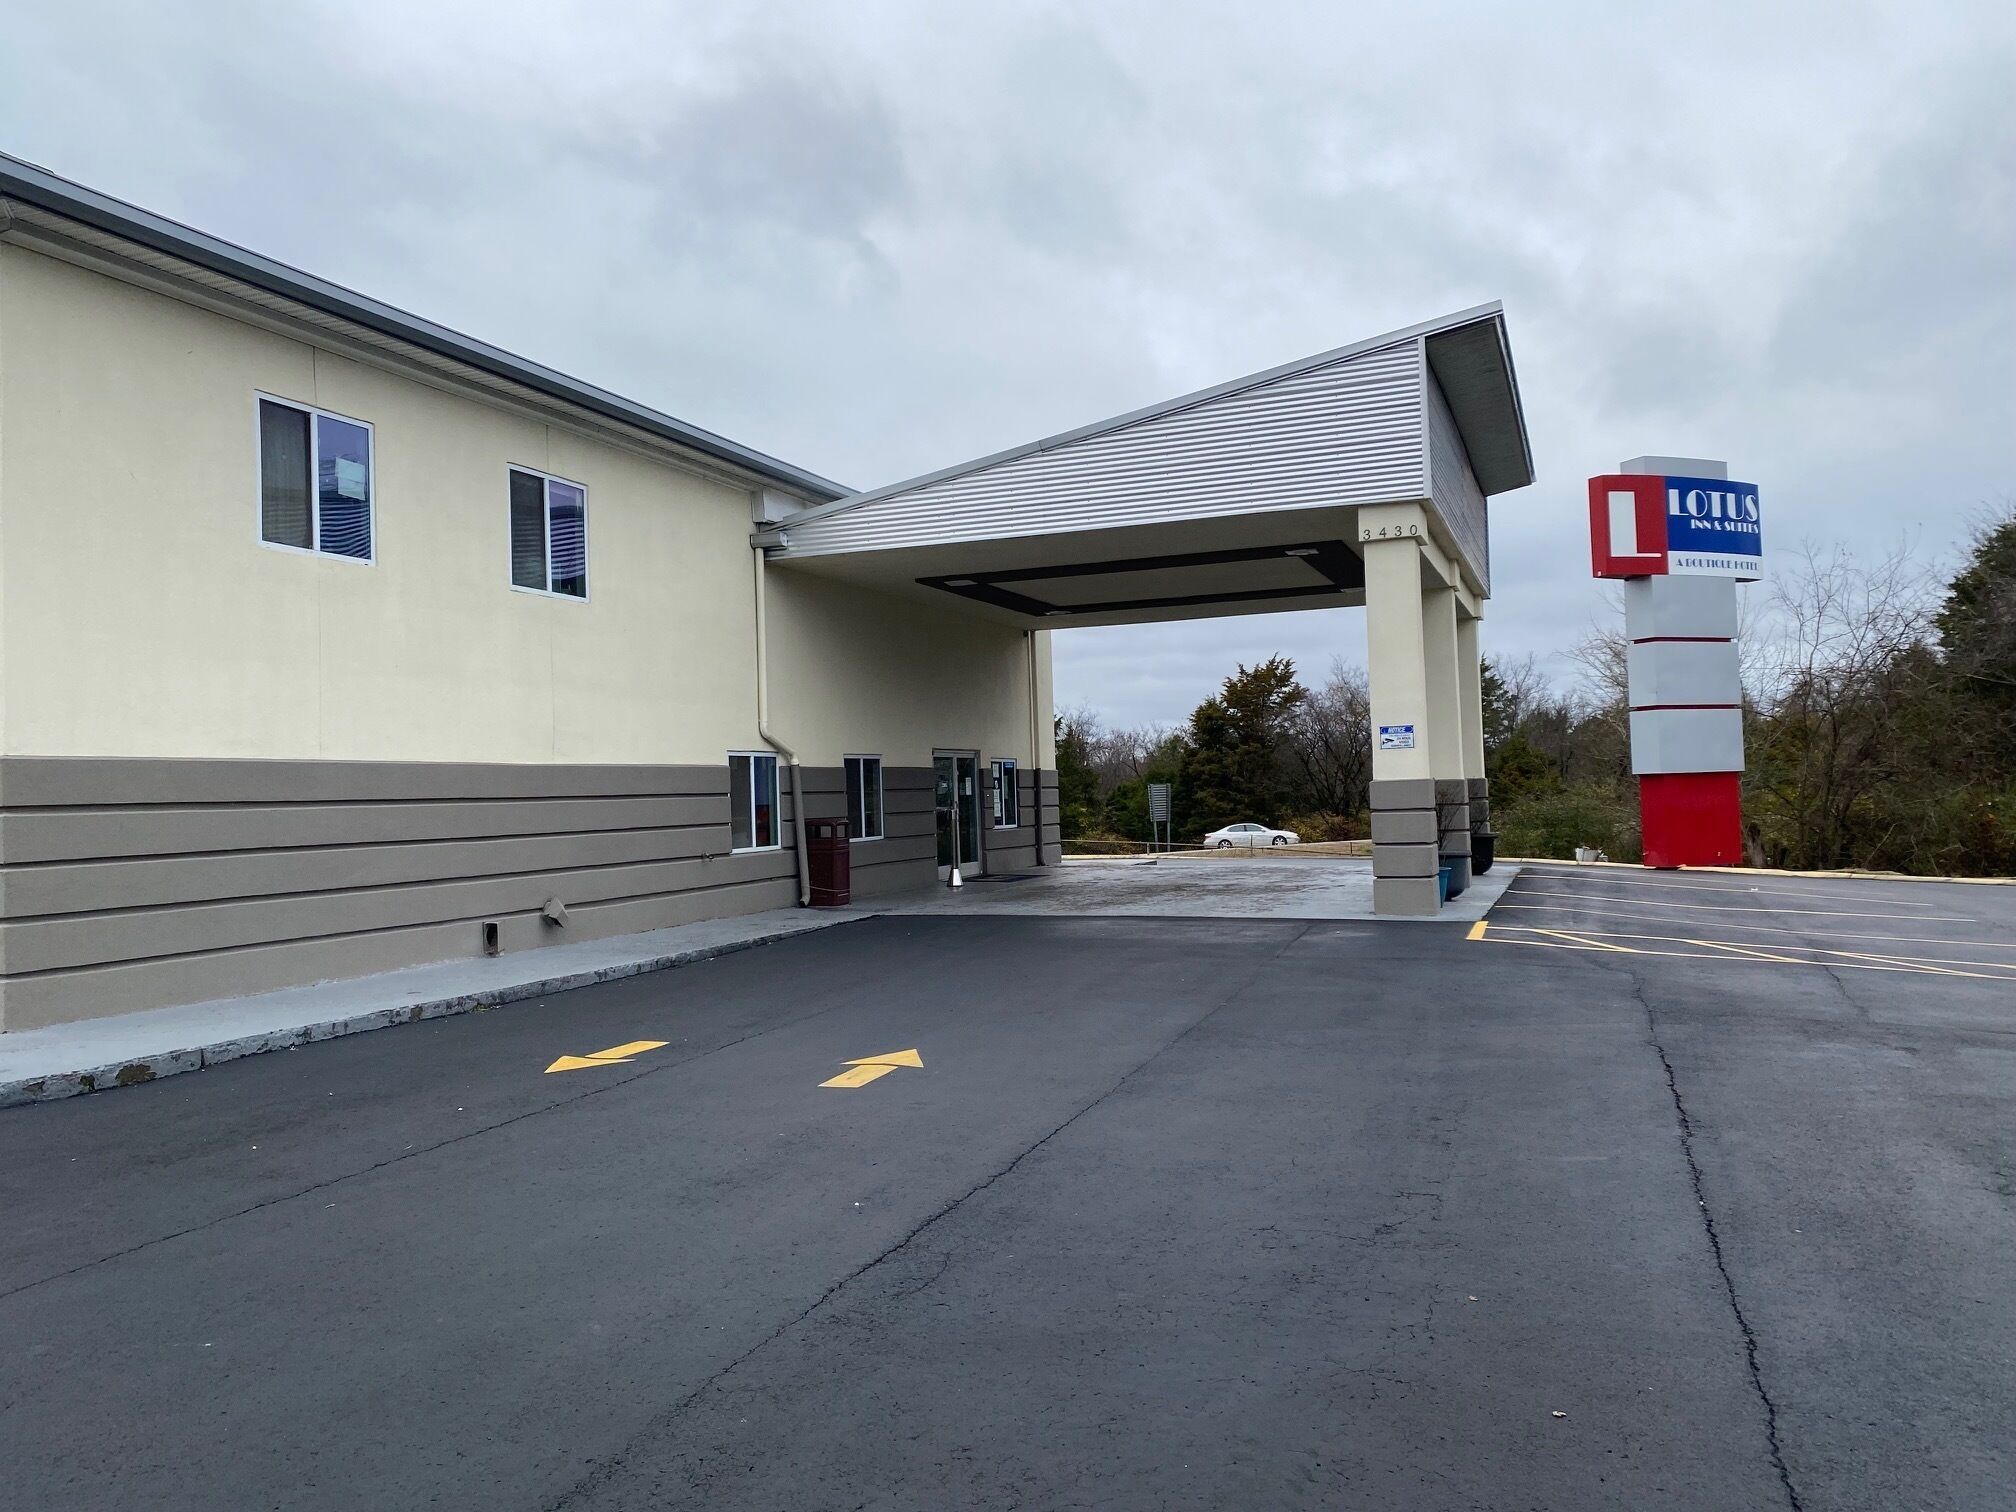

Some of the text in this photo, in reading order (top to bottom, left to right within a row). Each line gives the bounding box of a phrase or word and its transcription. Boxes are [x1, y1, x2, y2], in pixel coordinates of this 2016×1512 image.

[1668, 489, 1758, 521] LOTUS
[1363, 524, 1418, 540] 3430
[1608, 491, 1662, 557] L
[1690, 519, 1758, 533] INN & SUITES
[1676, 558, 1759, 571] A BOUTIQUE HOTEL
